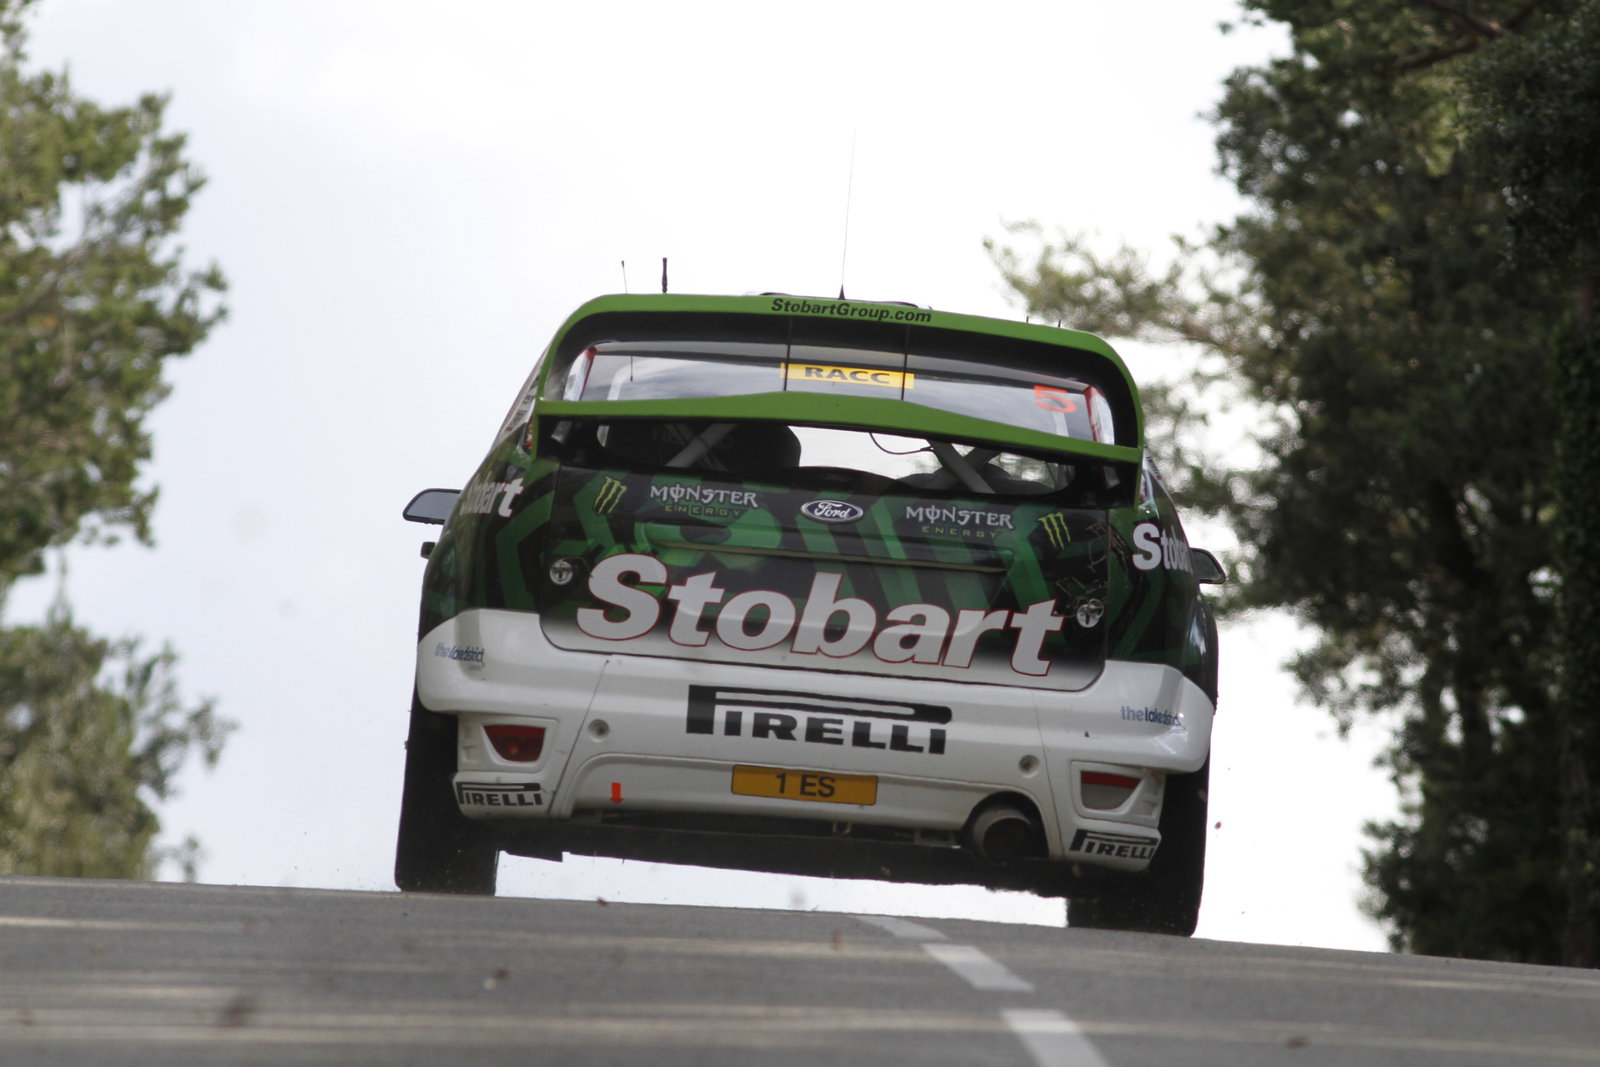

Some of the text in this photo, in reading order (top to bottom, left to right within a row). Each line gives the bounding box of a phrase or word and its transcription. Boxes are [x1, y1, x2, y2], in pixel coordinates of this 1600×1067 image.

[771, 298, 932, 322] StobartGroup.com
[804, 367, 891, 384] RACC
[1033, 385, 1077, 413] 5
[650, 484, 759, 508] MONSTER
[665, 504, 742, 517] ENERGY
[813, 500, 851, 519] Ford
[905, 505, 1014, 530] MONSTER
[922, 526, 997, 539] ENERGY
[576, 552, 1064, 677] Stobart
[686, 684, 952, 755] PIRELLI
[456, 782, 543, 806] PIRELLI
[776, 772, 836, 798] 1 ES
[1069, 829, 1159, 860] PIRELLI
